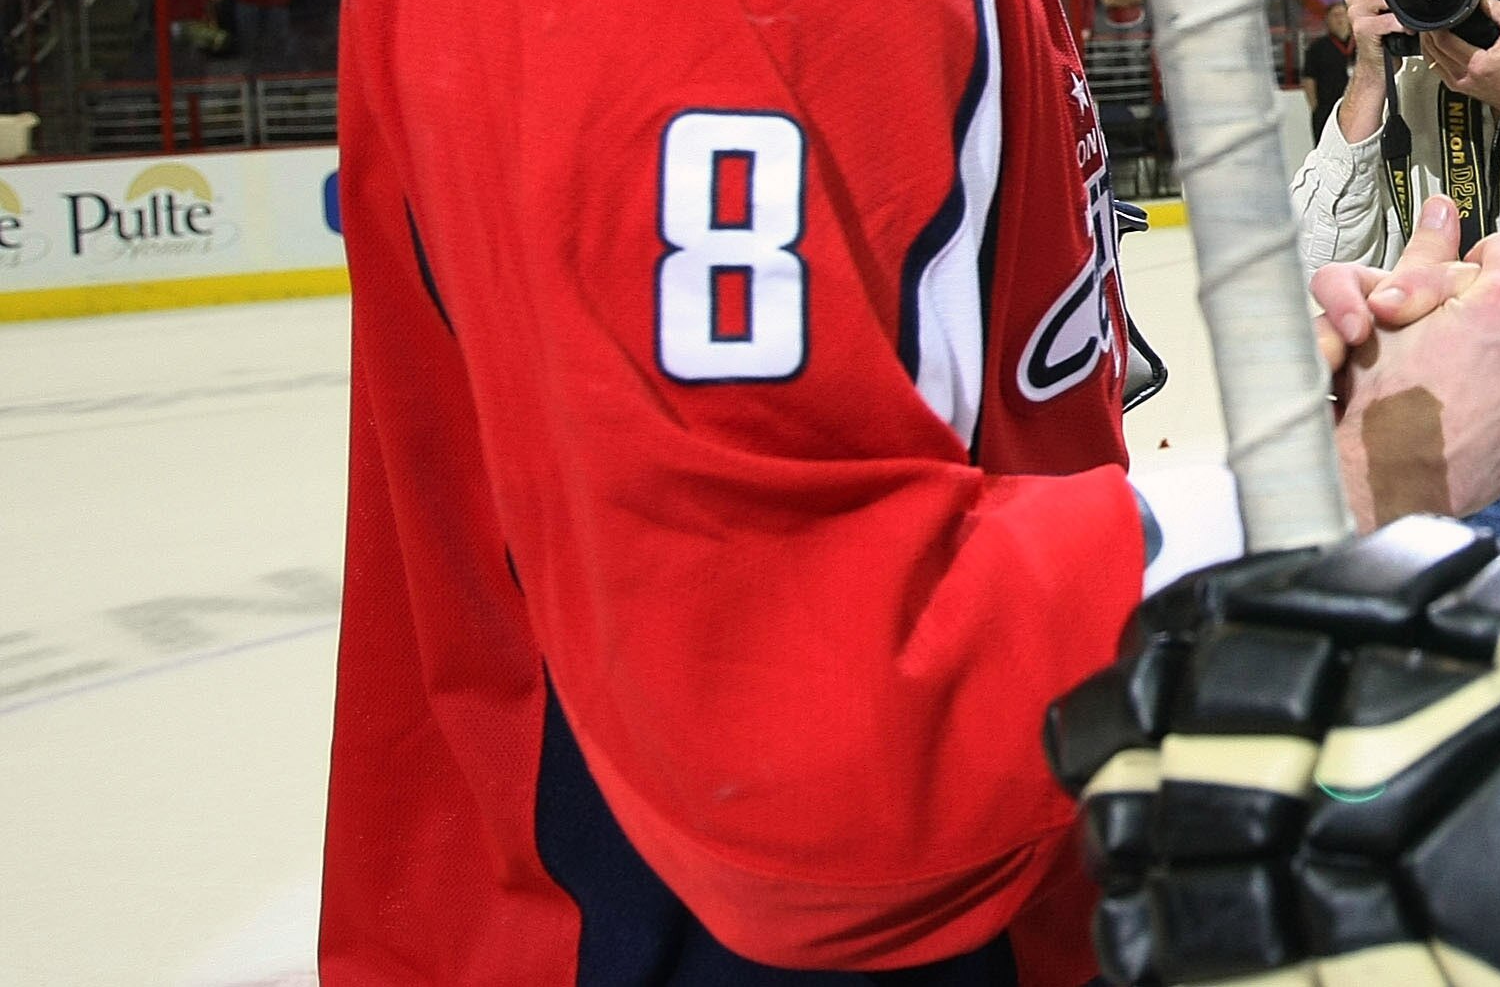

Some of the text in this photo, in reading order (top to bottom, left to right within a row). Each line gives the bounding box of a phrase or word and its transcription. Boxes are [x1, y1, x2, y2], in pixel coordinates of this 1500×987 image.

[1448, 101, 1466, 164] Nikon
[61, 190, 214, 255] Pulte
[654, 108, 808, 384] 8
